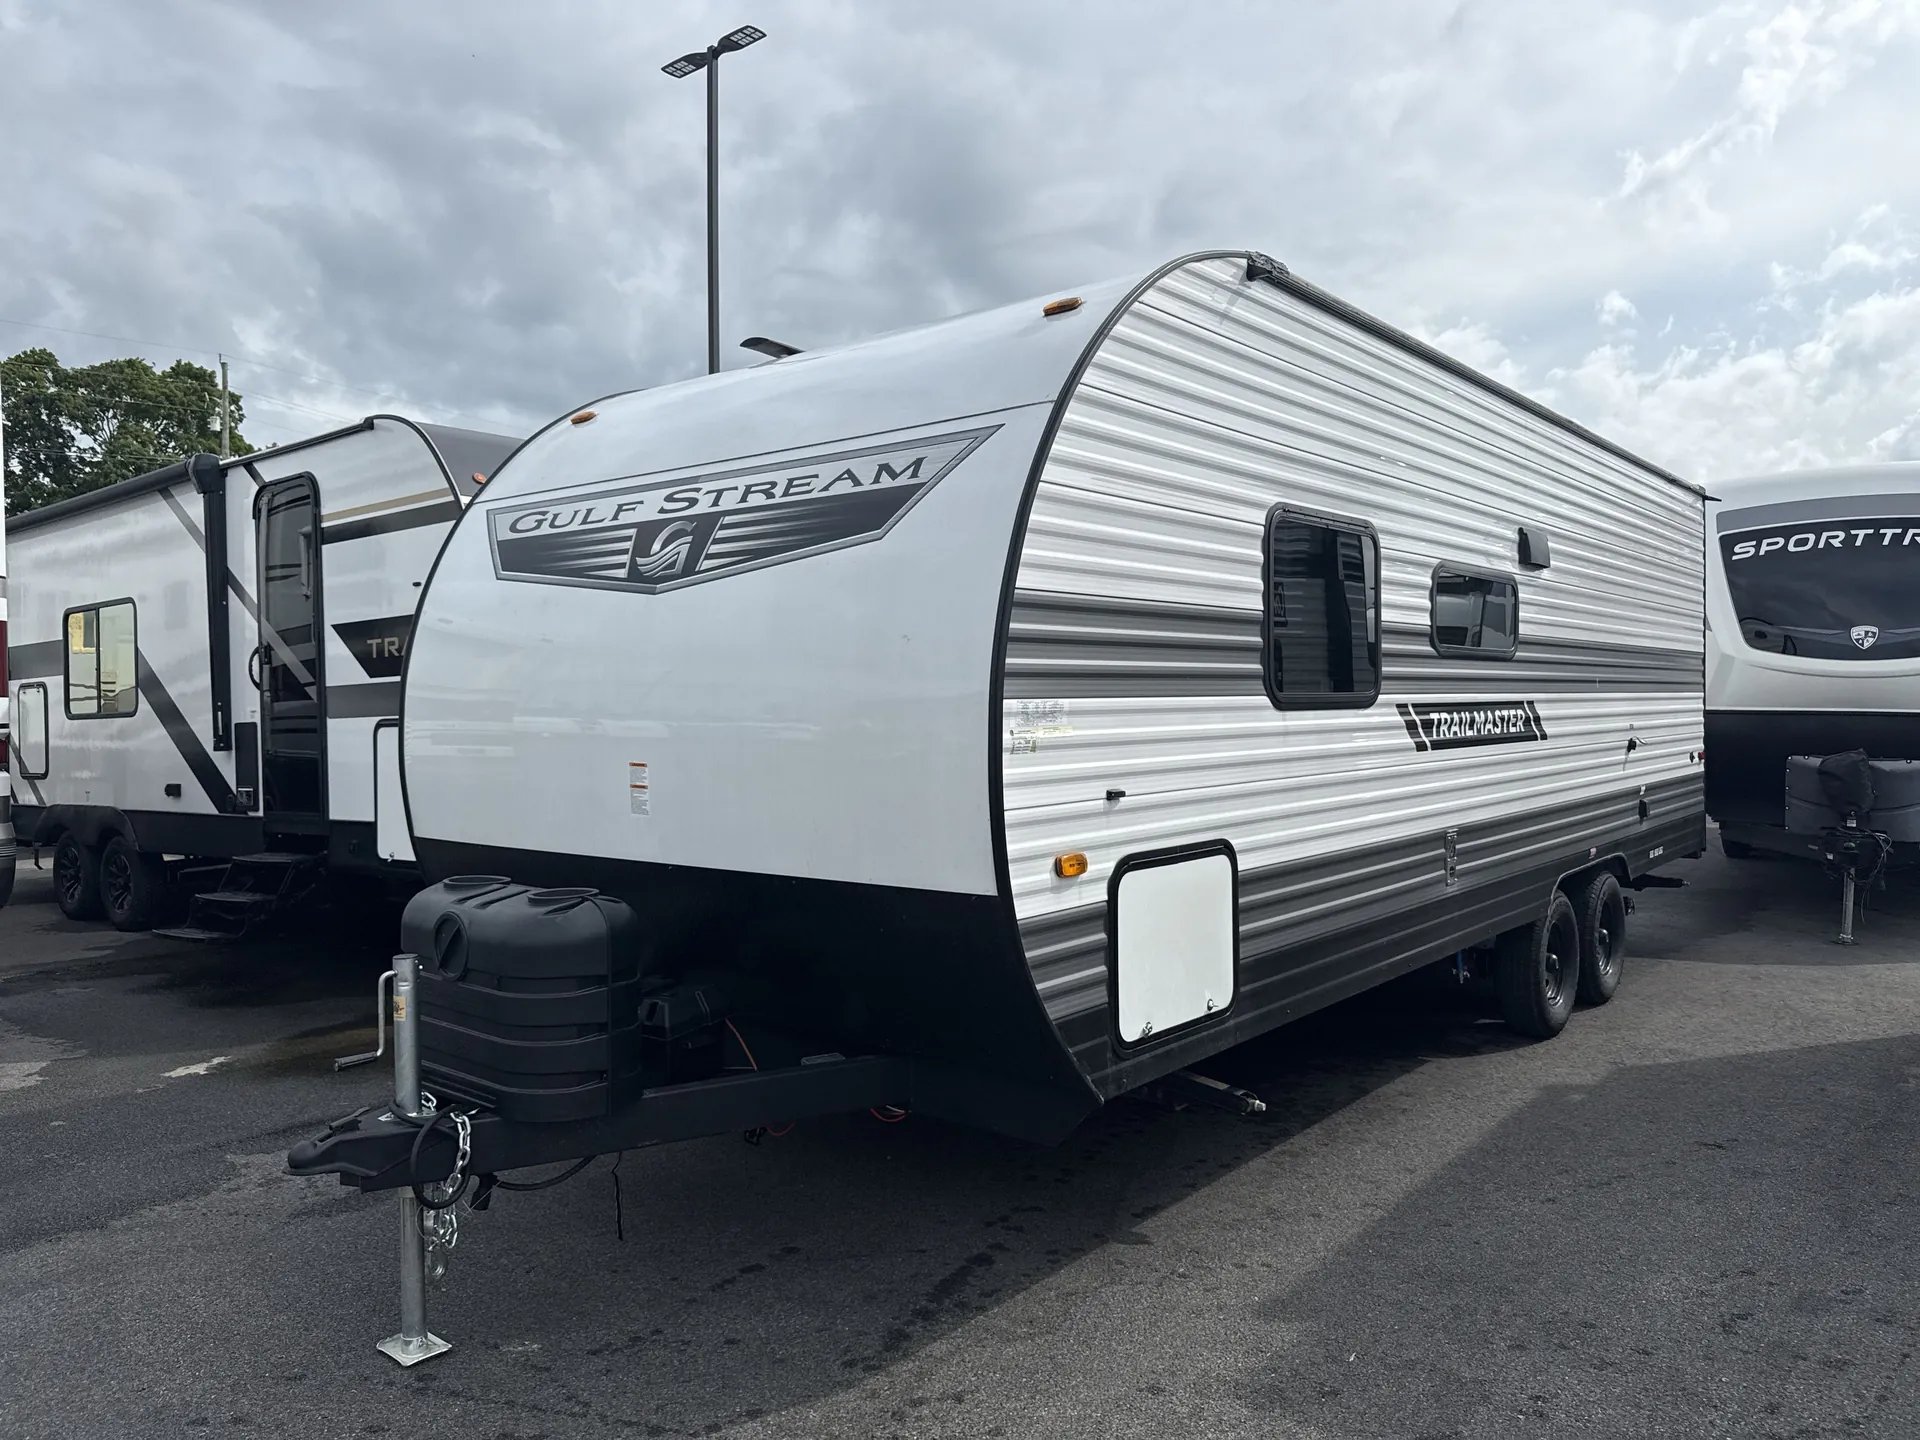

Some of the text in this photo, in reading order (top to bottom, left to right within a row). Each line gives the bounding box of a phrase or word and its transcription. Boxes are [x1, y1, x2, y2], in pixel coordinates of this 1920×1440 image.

[508, 456, 928, 534] GULF STREAM
[1429, 709, 1526, 739] TRAILMASTER
